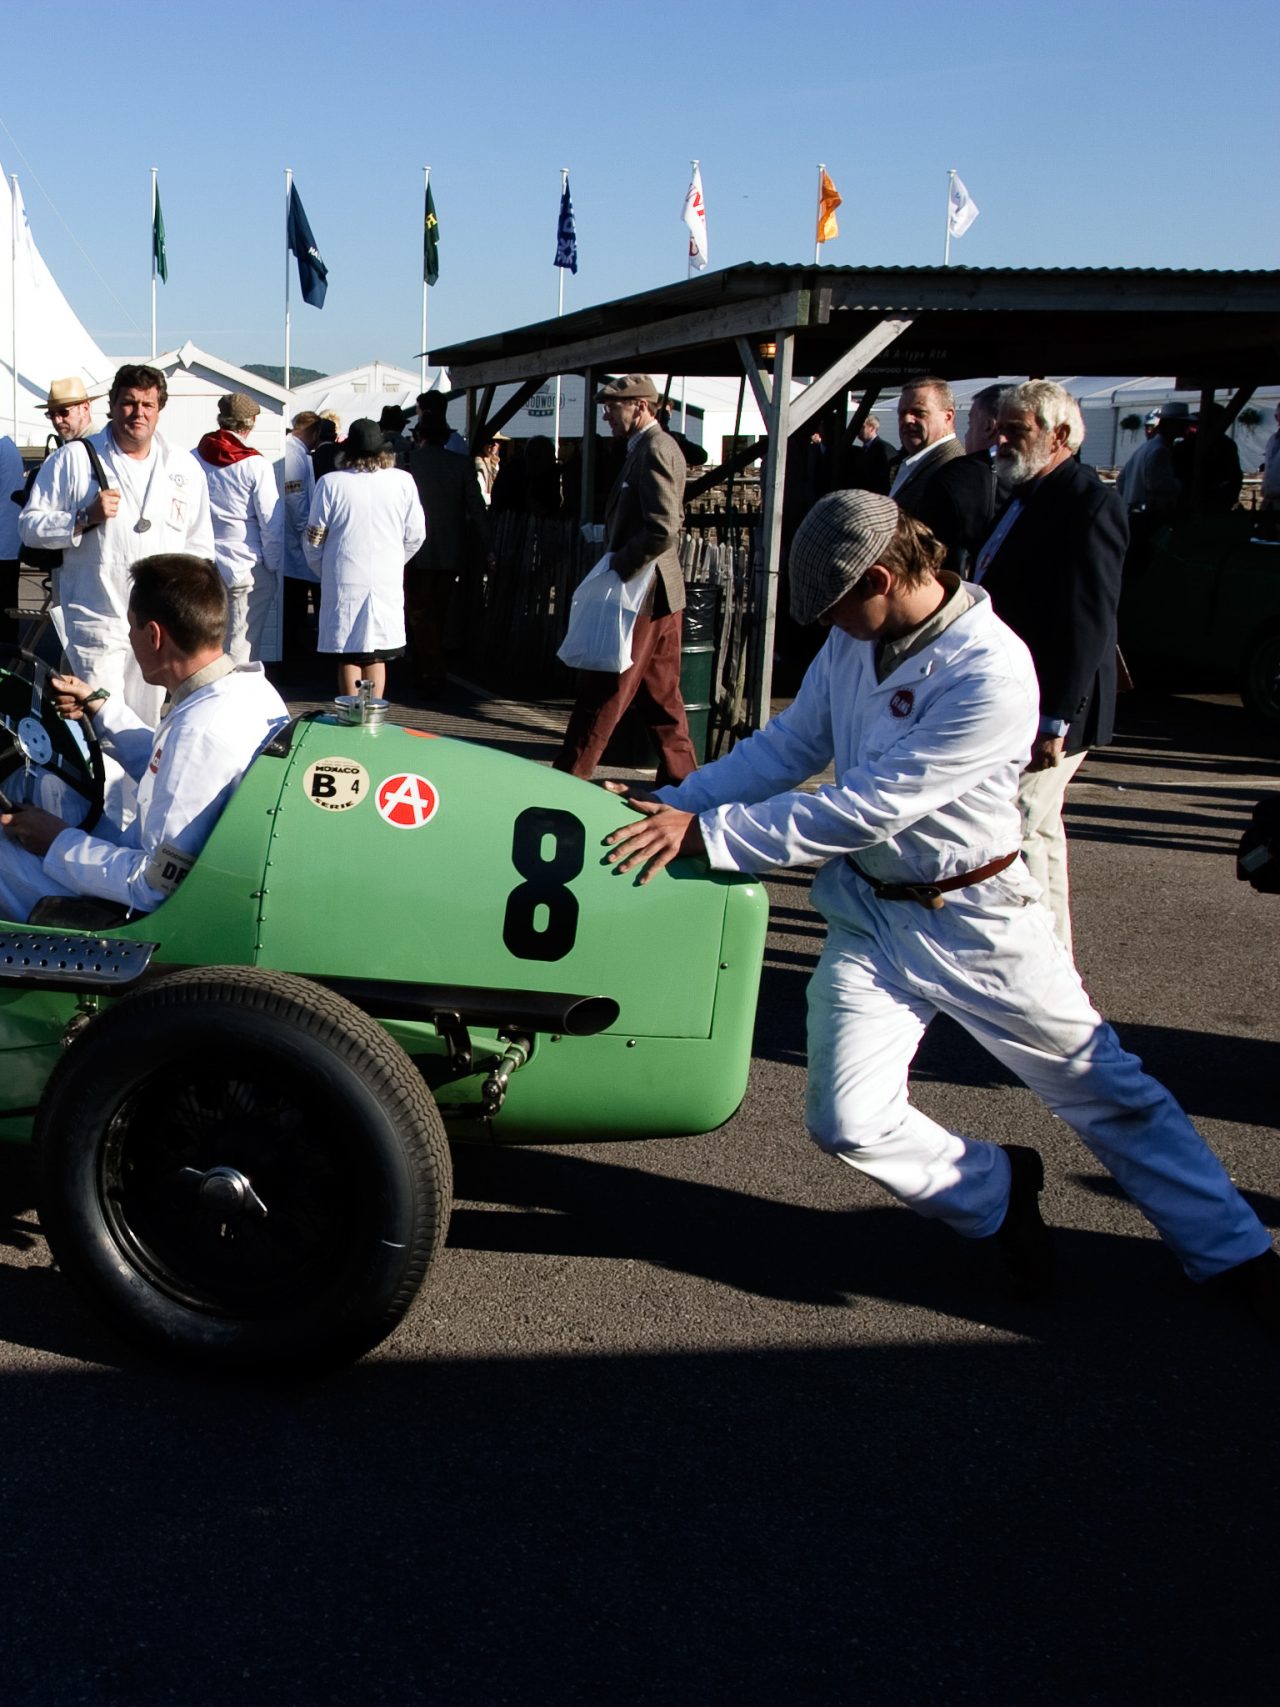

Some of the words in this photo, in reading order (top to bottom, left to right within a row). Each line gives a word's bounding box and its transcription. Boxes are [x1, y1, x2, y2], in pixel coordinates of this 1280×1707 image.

[315, 766, 360, 774] MONACO
[311, 773, 337, 798] B
[351, 779, 360, 795] 4
[503, 806, 586, 962] 8
